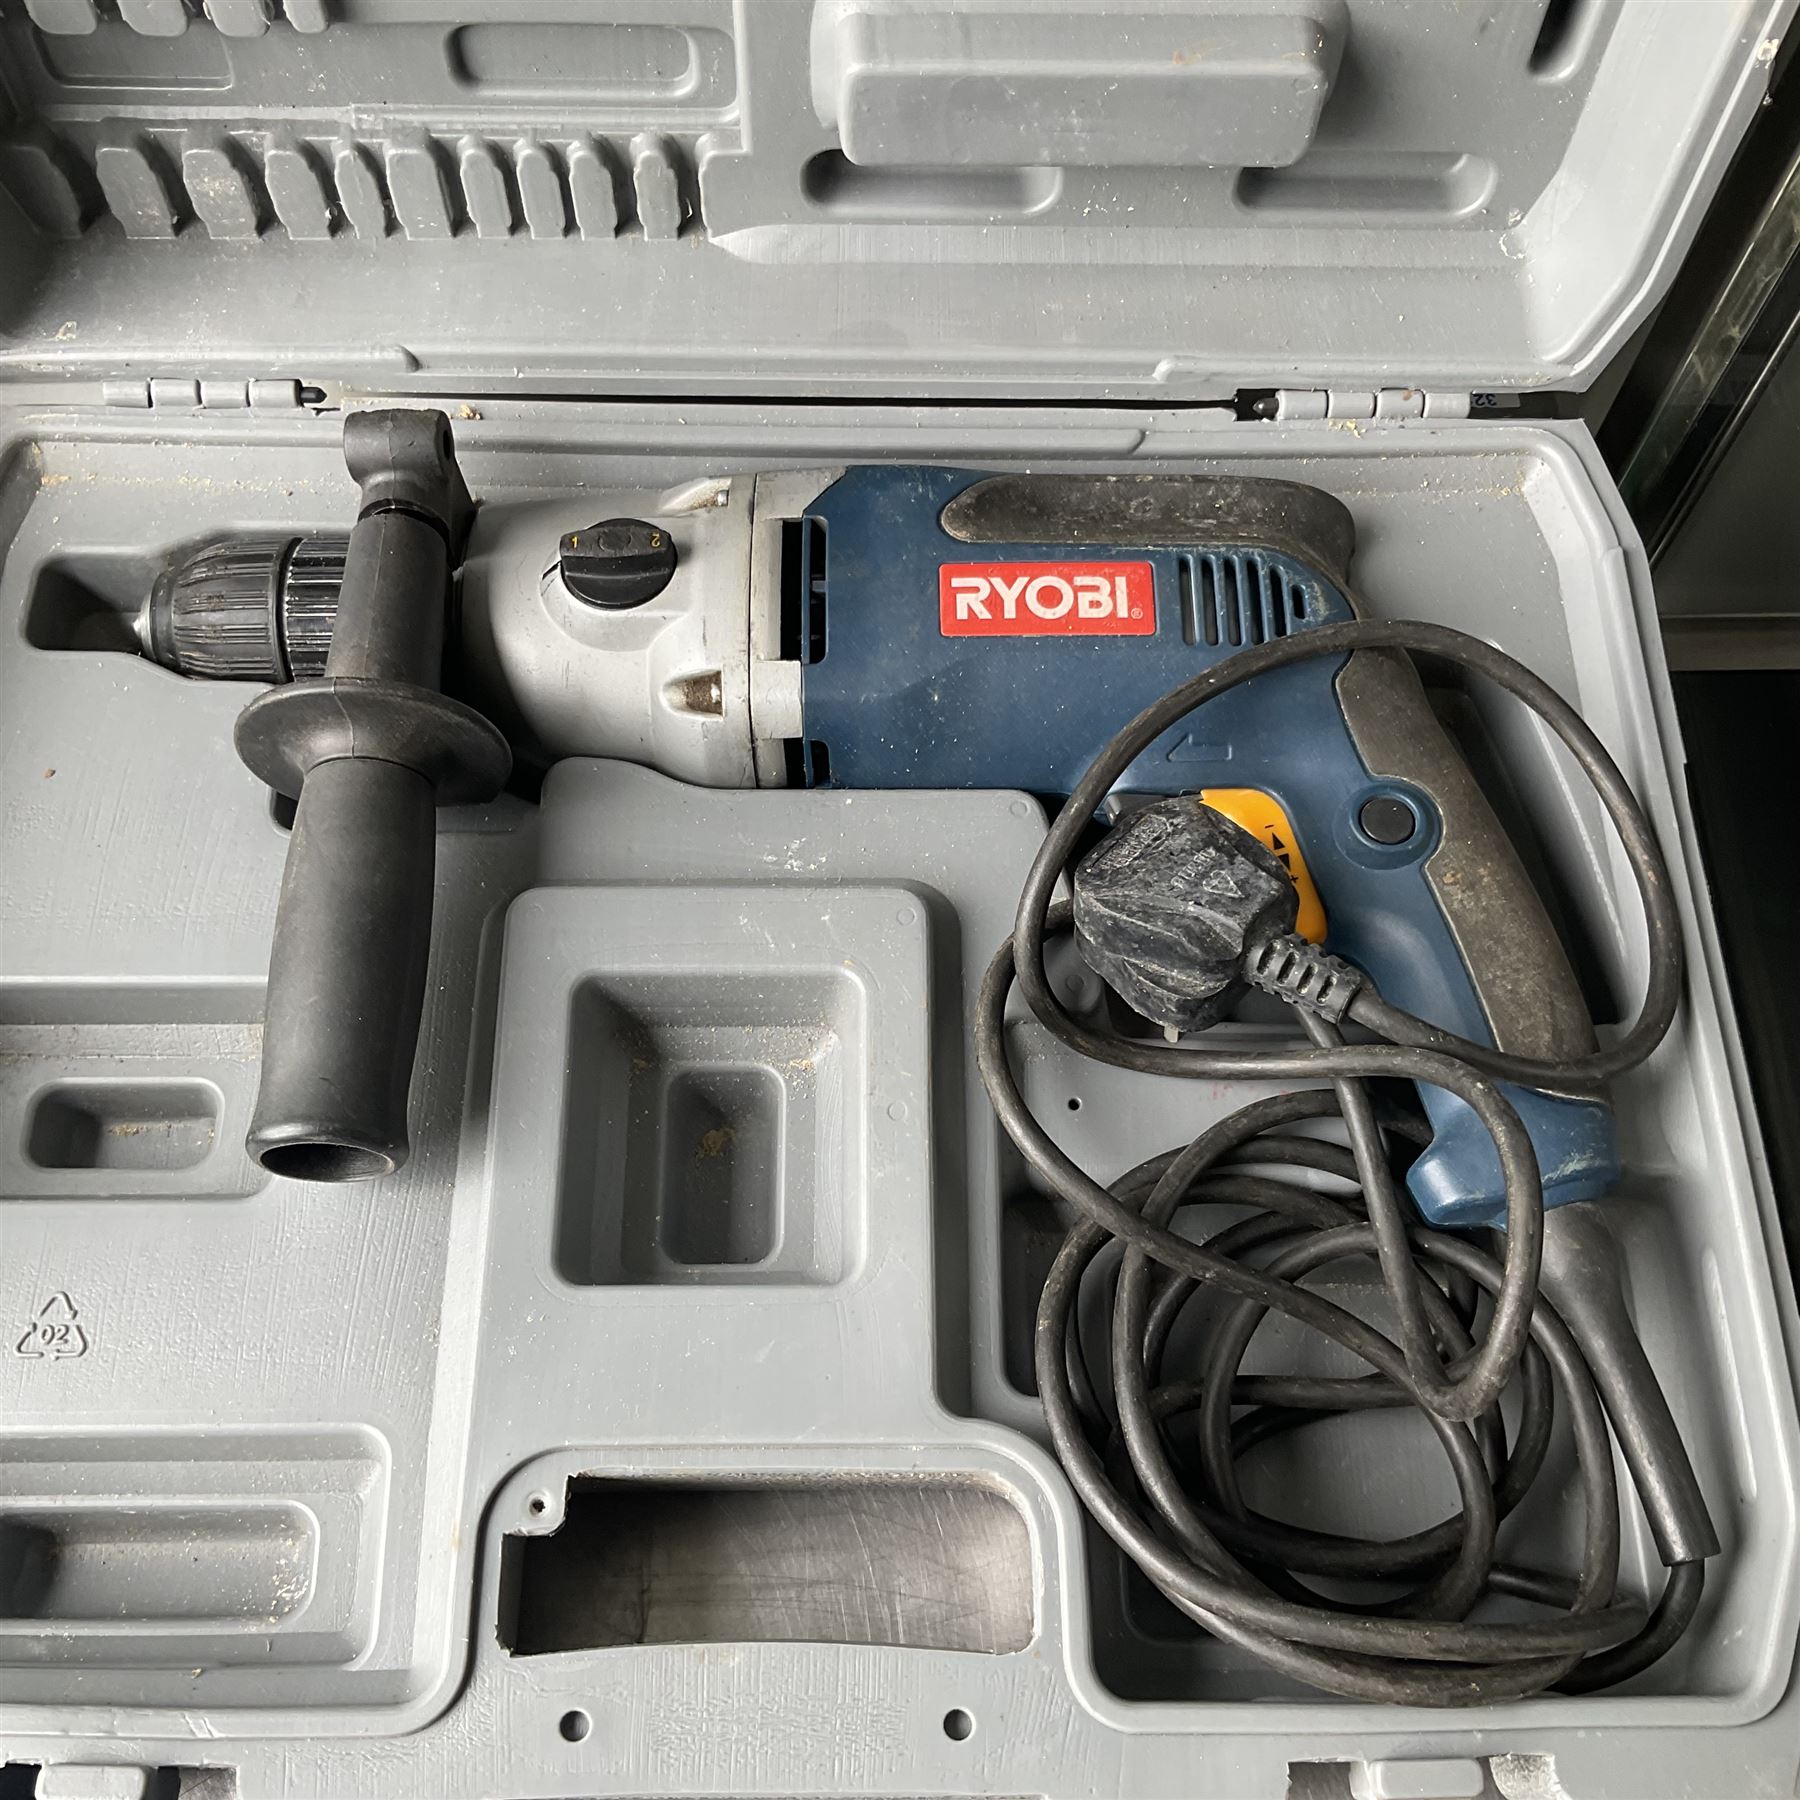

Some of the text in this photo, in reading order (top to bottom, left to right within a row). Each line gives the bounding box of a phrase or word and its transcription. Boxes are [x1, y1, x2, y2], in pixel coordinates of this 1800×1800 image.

[1471, 393, 1497, 406] 32
[571, 535, 579, 549] 1
[650, 532, 661, 548] 2
[41, 1324, 70, 1345] 02
